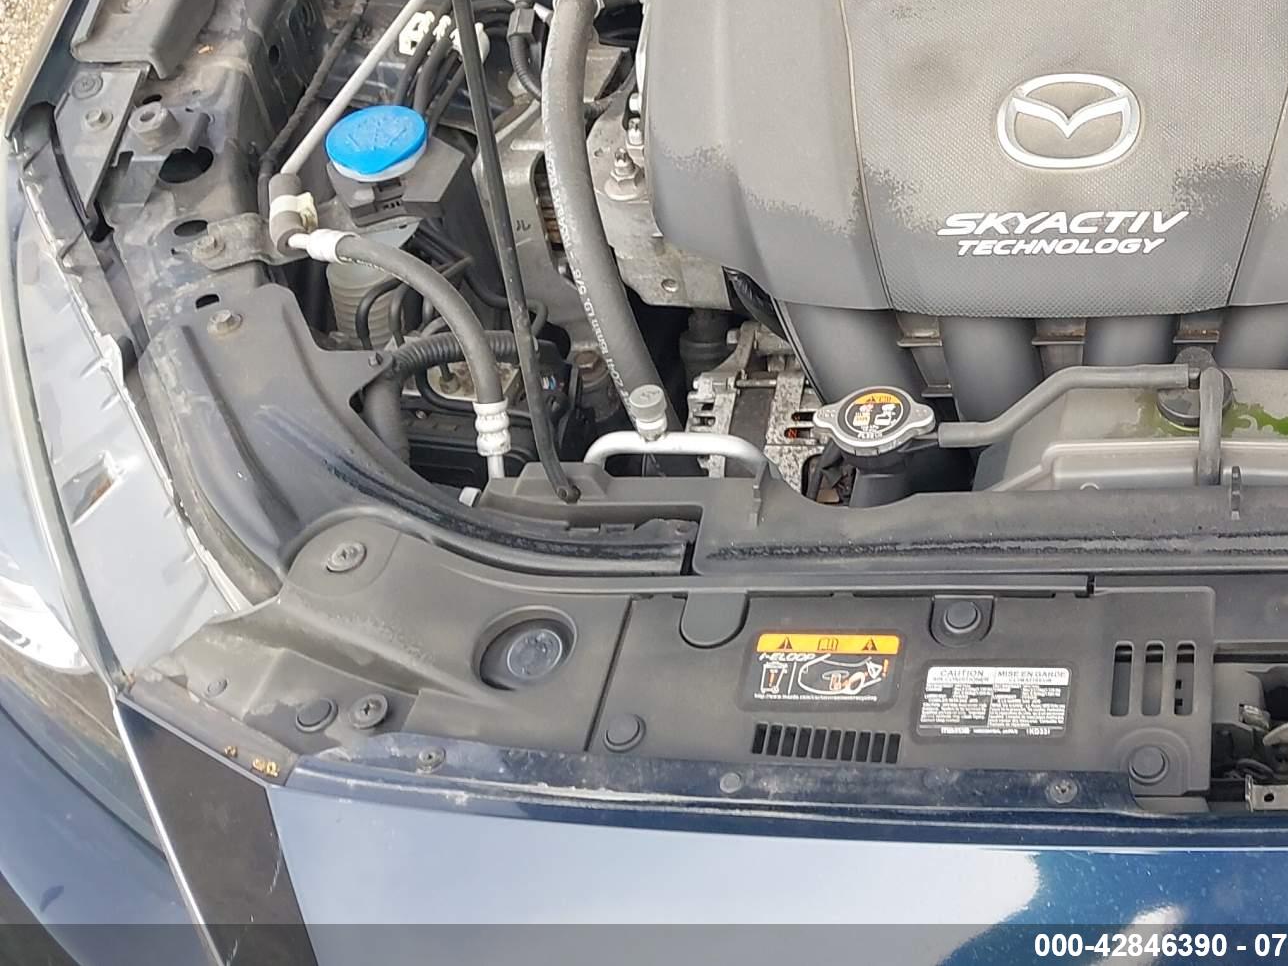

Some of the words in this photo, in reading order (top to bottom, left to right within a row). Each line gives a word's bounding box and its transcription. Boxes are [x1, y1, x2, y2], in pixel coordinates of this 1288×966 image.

[936, 211, 1190, 236] SKYACTIV
[957, 238, 1166, 257] TECHNOLOGY
[940, 669, 984, 677] CAUTION
